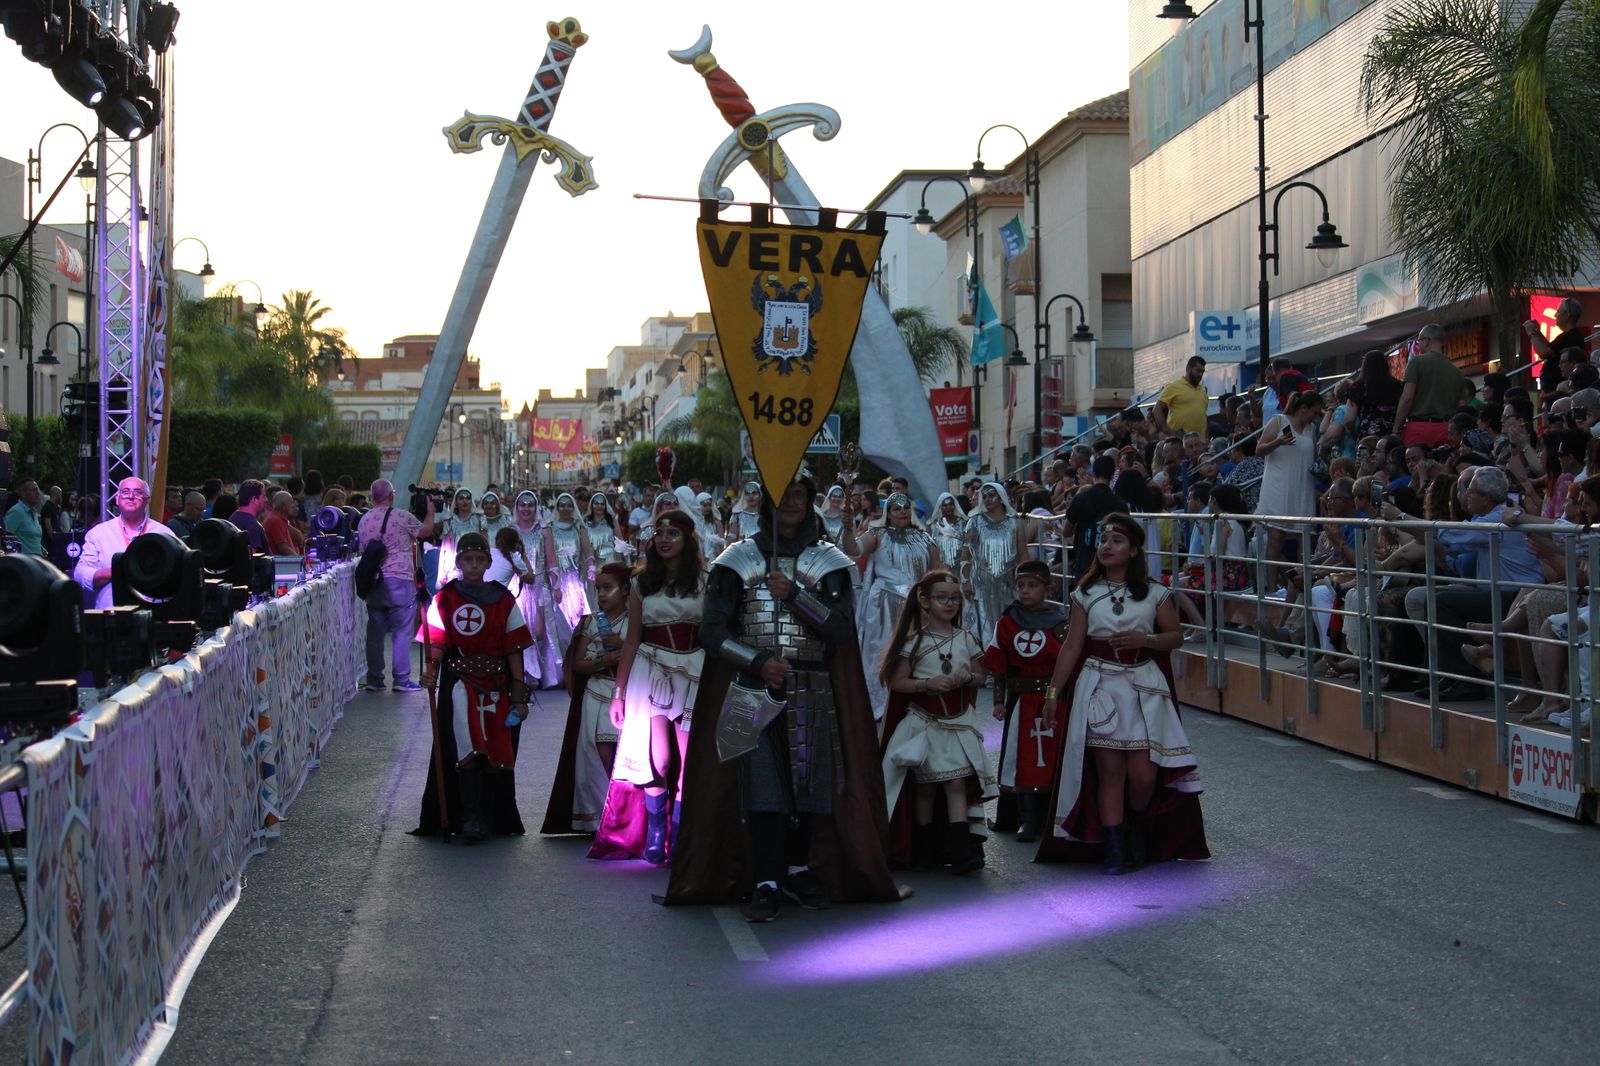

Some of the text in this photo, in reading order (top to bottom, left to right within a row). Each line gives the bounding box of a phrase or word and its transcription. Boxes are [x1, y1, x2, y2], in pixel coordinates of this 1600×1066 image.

[703, 230, 868, 278] VERA
[748, 392, 814, 427] 1488
[935, 404, 967, 416] Vota
[1526, 744, 1576, 793] TP SPOR
